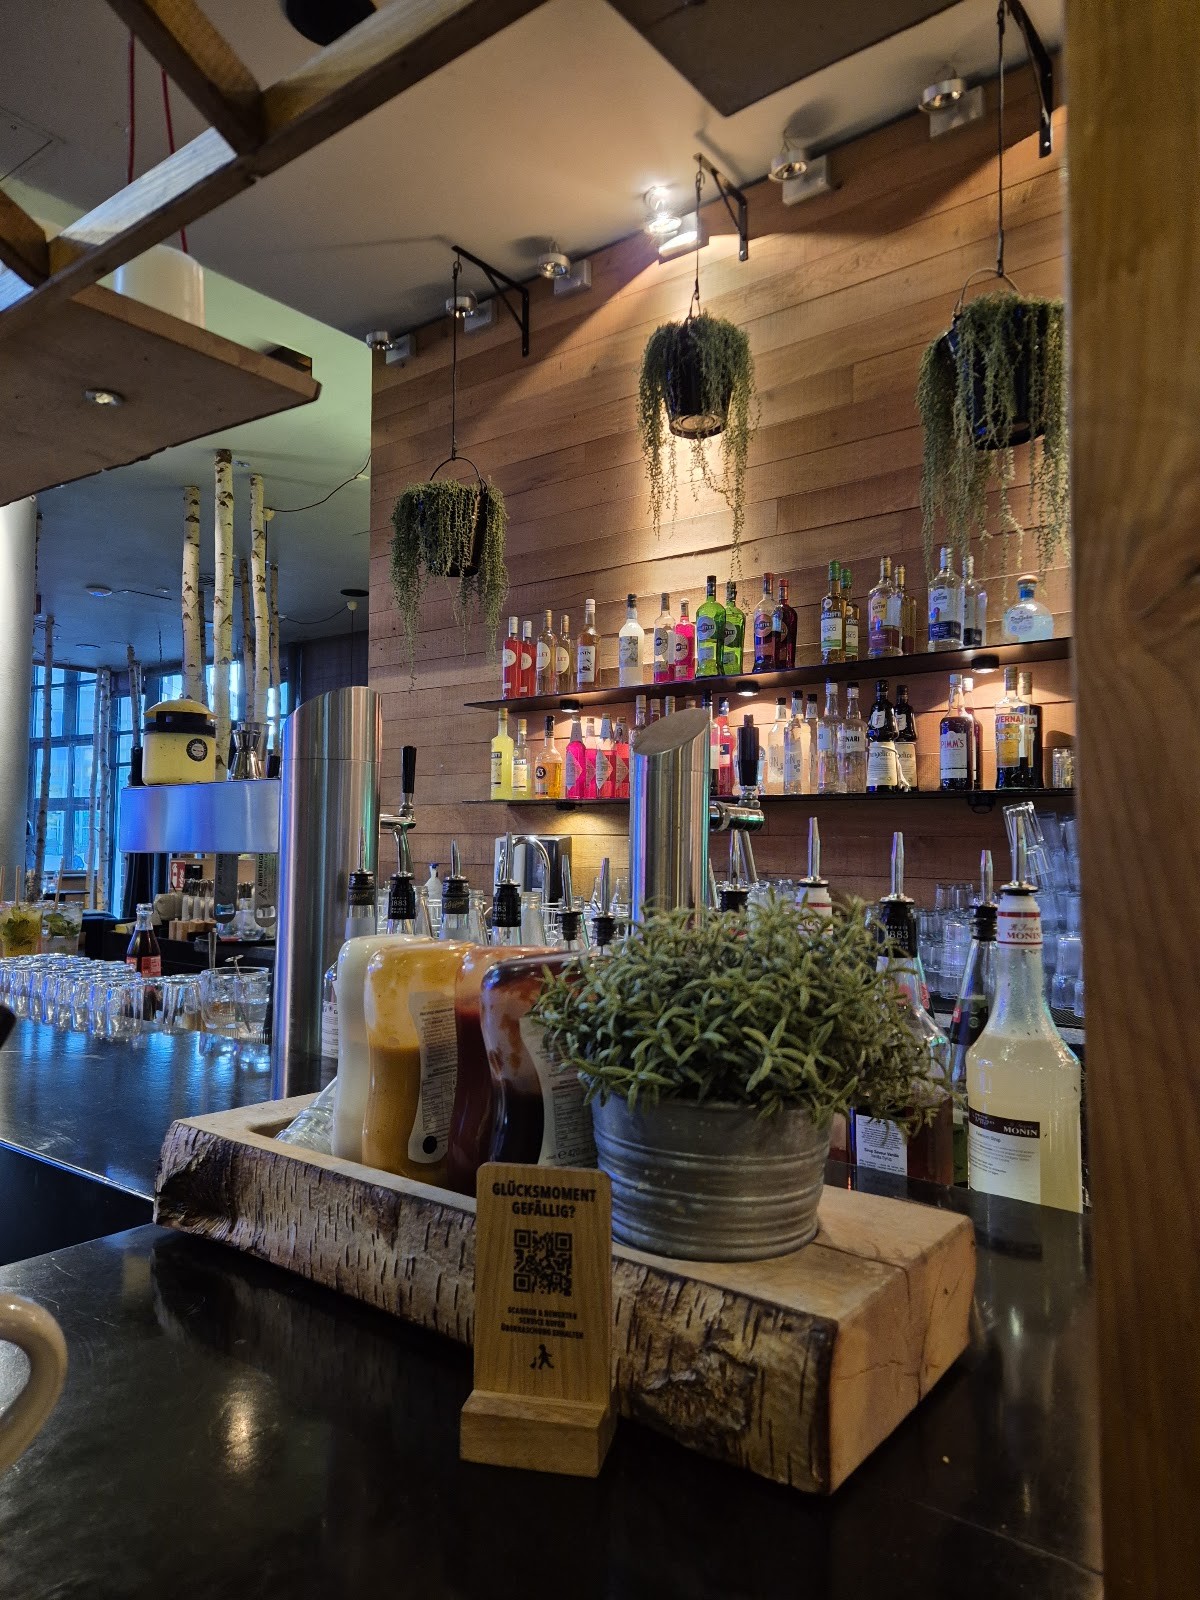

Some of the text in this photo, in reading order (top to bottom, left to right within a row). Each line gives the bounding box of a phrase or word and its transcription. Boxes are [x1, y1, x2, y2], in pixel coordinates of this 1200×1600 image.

[1003, 1125, 1038, 1136] MONIN
[492, 1180, 597, 1202] GLÜCKSMOMENT
[512, 1199, 576, 1218] GEFÄLLIG?
